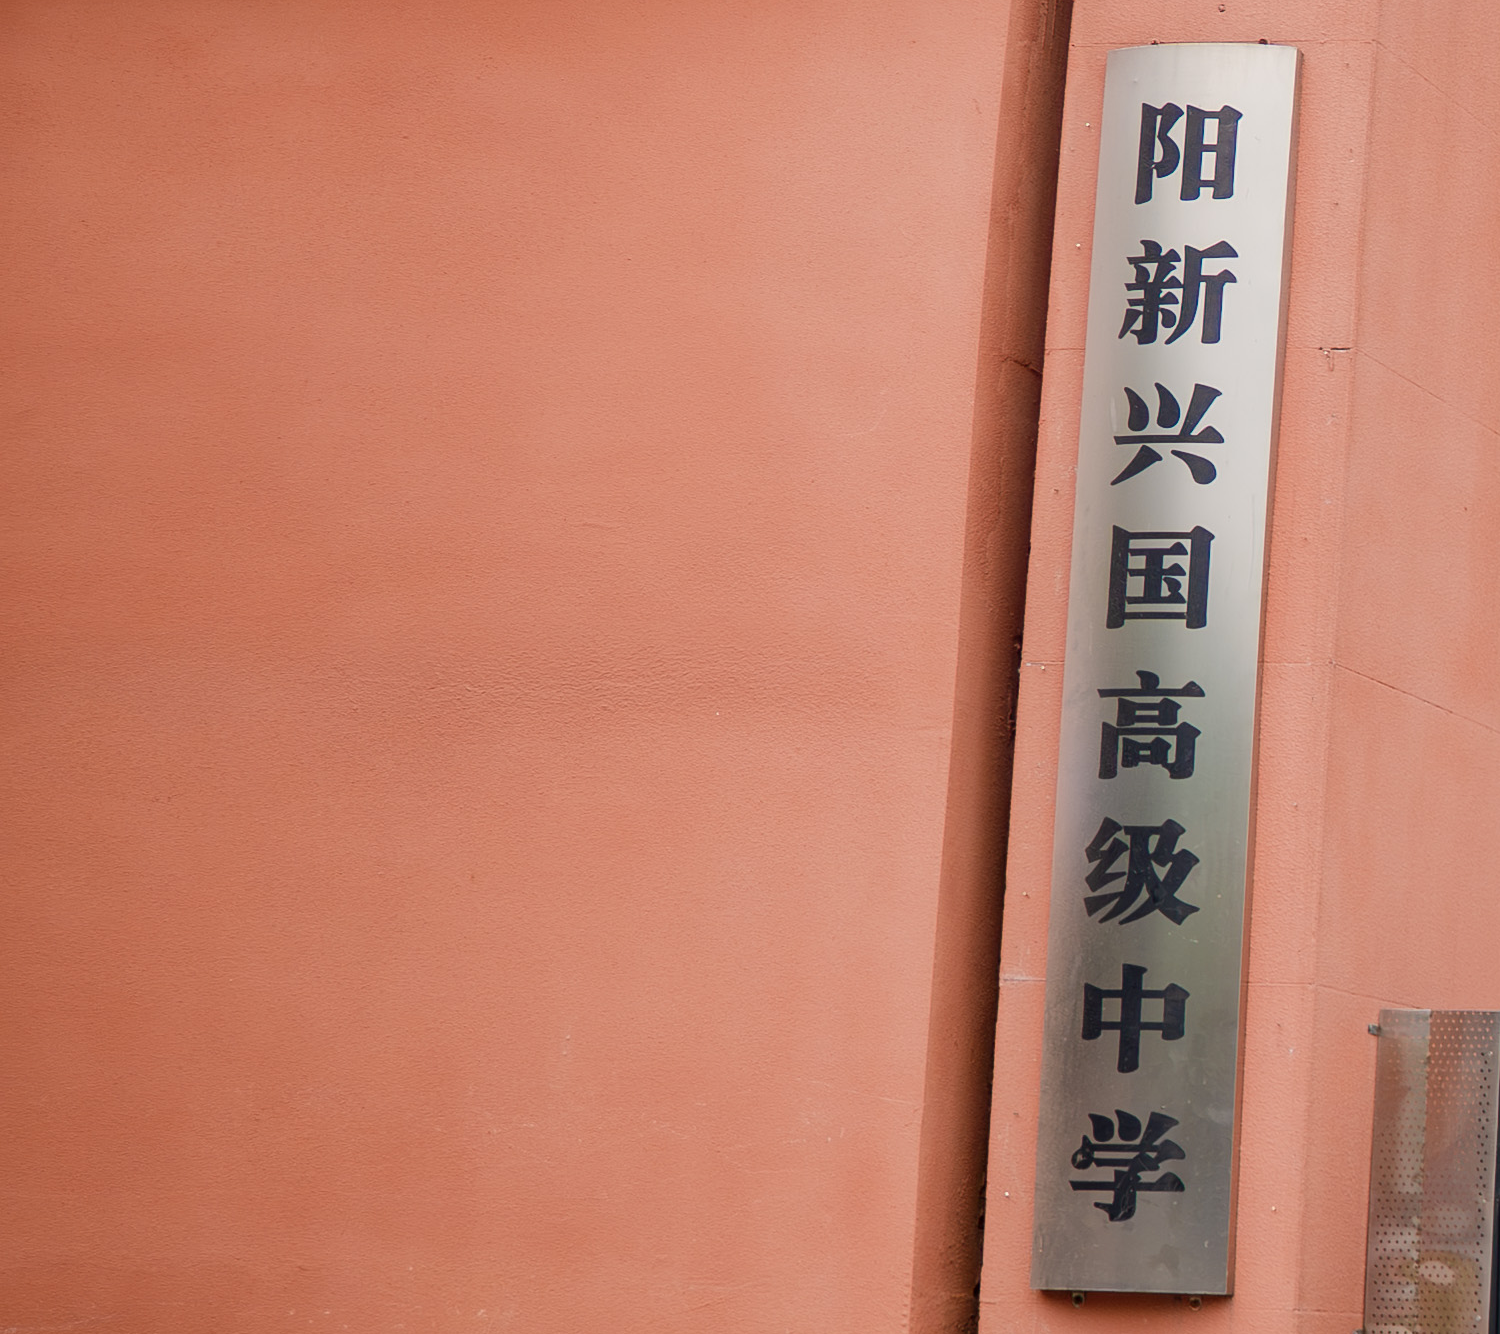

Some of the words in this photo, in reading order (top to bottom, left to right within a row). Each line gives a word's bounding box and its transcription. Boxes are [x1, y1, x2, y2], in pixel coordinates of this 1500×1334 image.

[1068, 101, 1244, 1223] 阳新兴国高级中学
